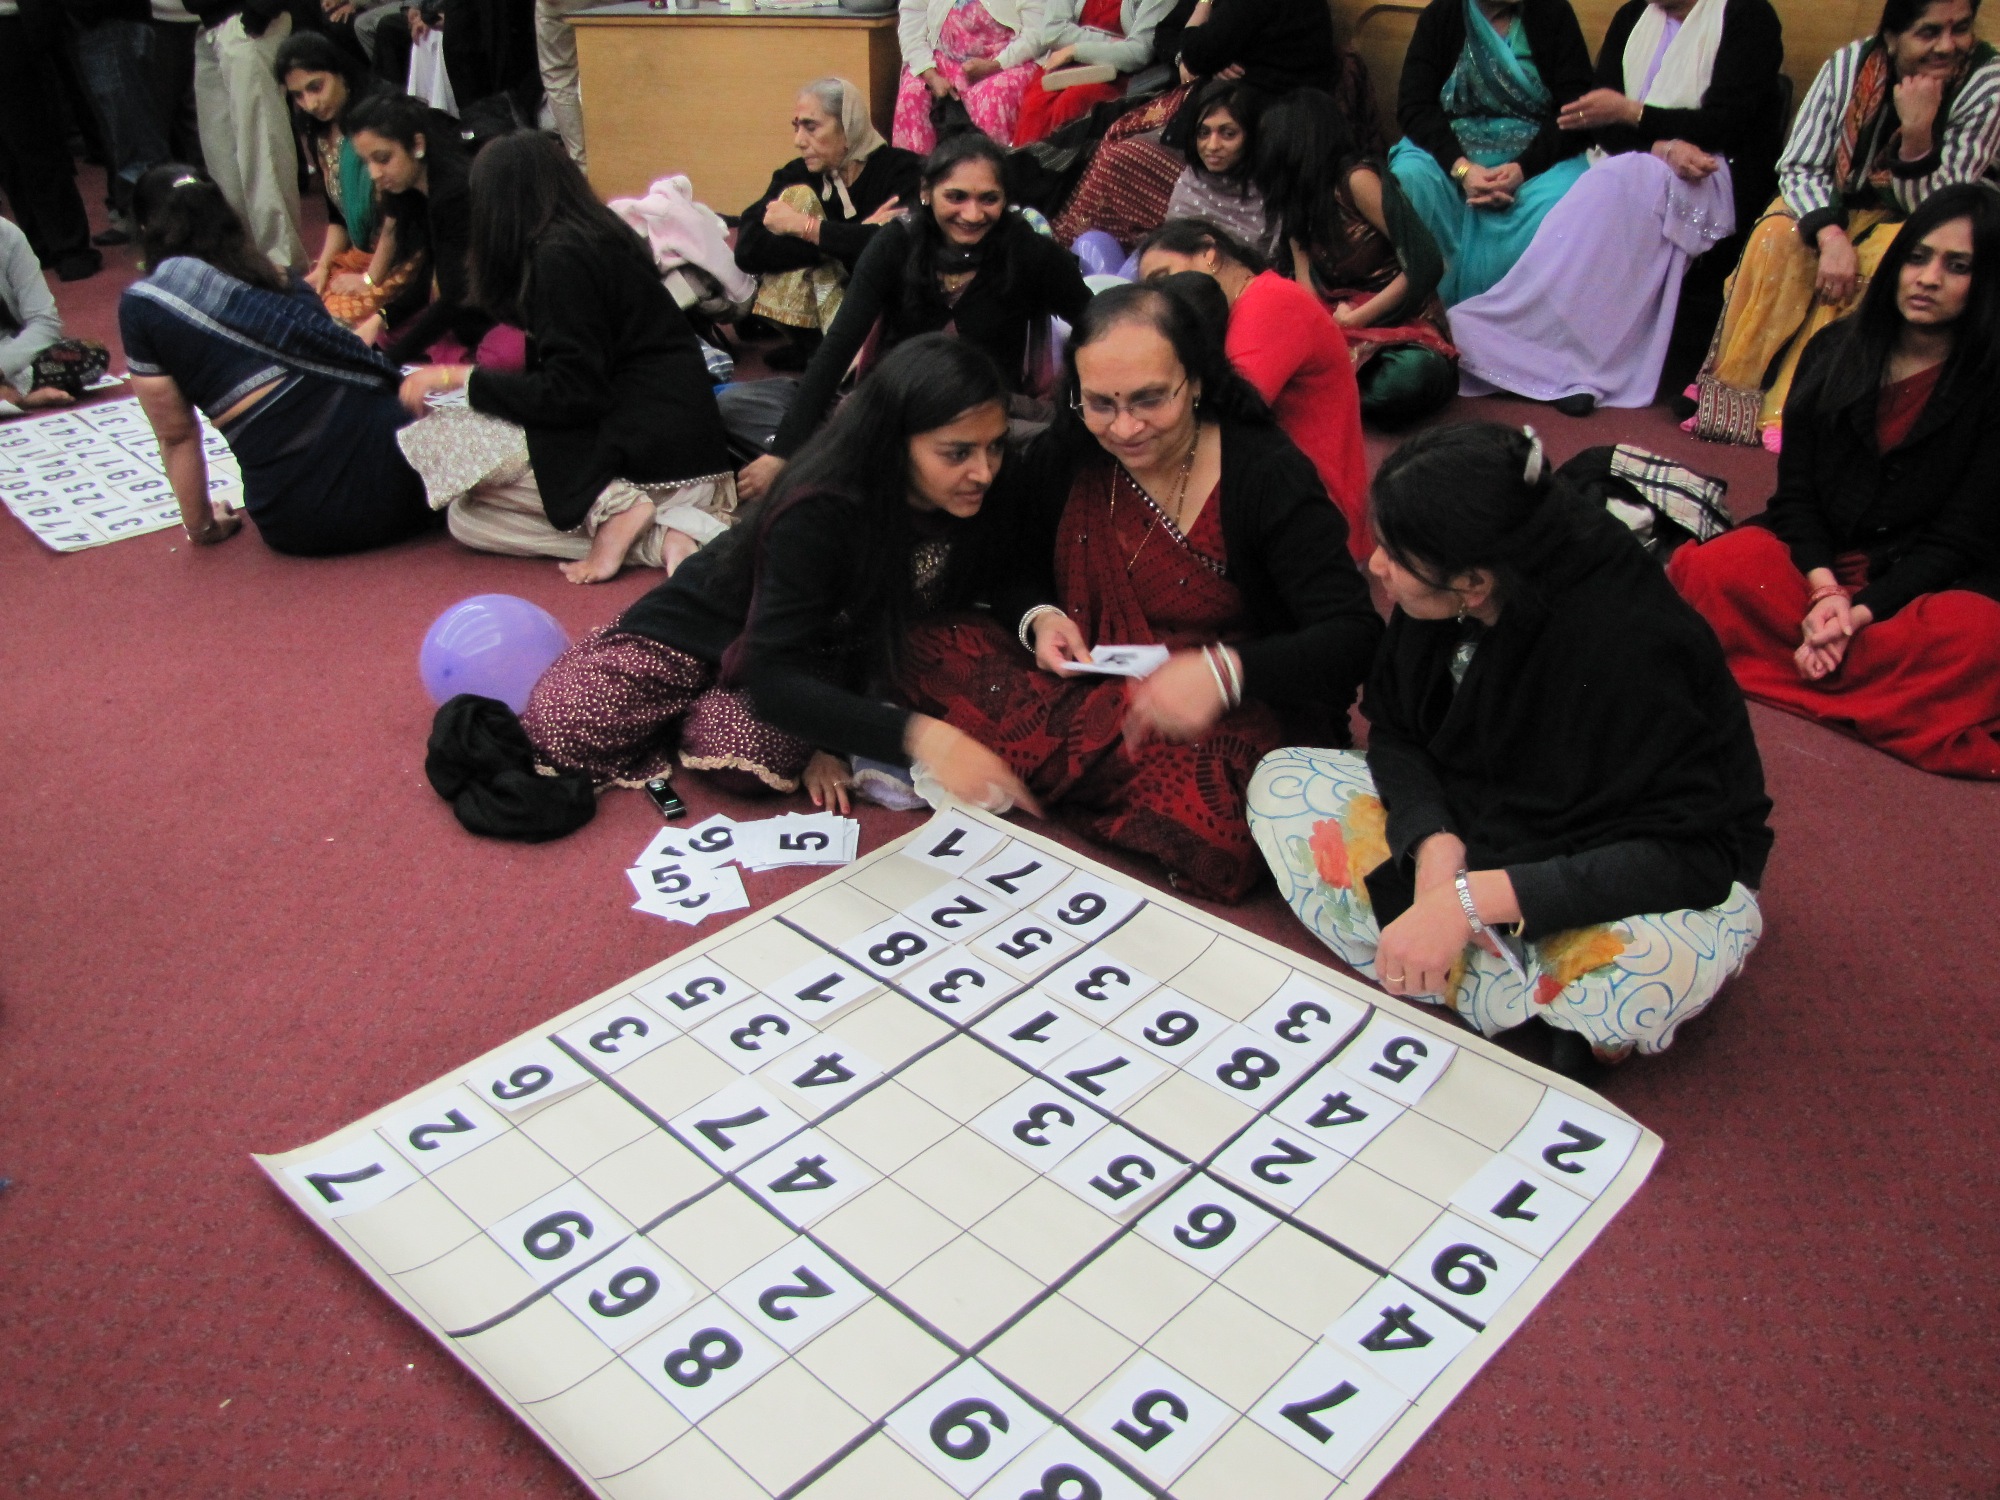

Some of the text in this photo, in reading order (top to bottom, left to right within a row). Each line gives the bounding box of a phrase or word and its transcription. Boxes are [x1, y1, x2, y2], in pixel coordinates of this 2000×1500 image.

[780, 832, 829, 850] 5
[928, 828, 967, 857] 1
[652, 865, 691, 893] 5
[985, 861, 1042, 894] 7
[931, 895, 987, 928] 2
[868, 932, 927, 966] 8
[996, 927, 1052, 959] 5
[795, 973, 844, 1002] 1
[929, 968, 985, 1003] 3
[1075, 966, 1130, 1000] 3
[1009, 1011, 1058, 1043] 1
[1275, 1002, 1331, 1043] 3
[1065, 1057, 1130, 1096] 7
[1217, 1048, 1280, 1090] 8
[1369, 1037, 1427, 1083] 5
[1013, 1103, 1074, 1146] 3
[1306, 1092, 1368, 1128] 4
[409, 1110, 475, 1150] 2
[1542, 1121, 1605, 1173] 2
[1089, 1155, 1155, 1200] 5
[1251, 1138, 1316, 1184] 2
[305, 1165, 382, 1203] 7
[1491, 1180, 1538, 1221] 1
[667, 977, 1359, 1444] 7 4 3 5
[590, 1018, 1188, 1451] 5 4 7 3
[759, 1267, 834, 1321] 2
[1359, 1304, 1434, 1351] 4
[664, 1329, 742, 1387] 8
